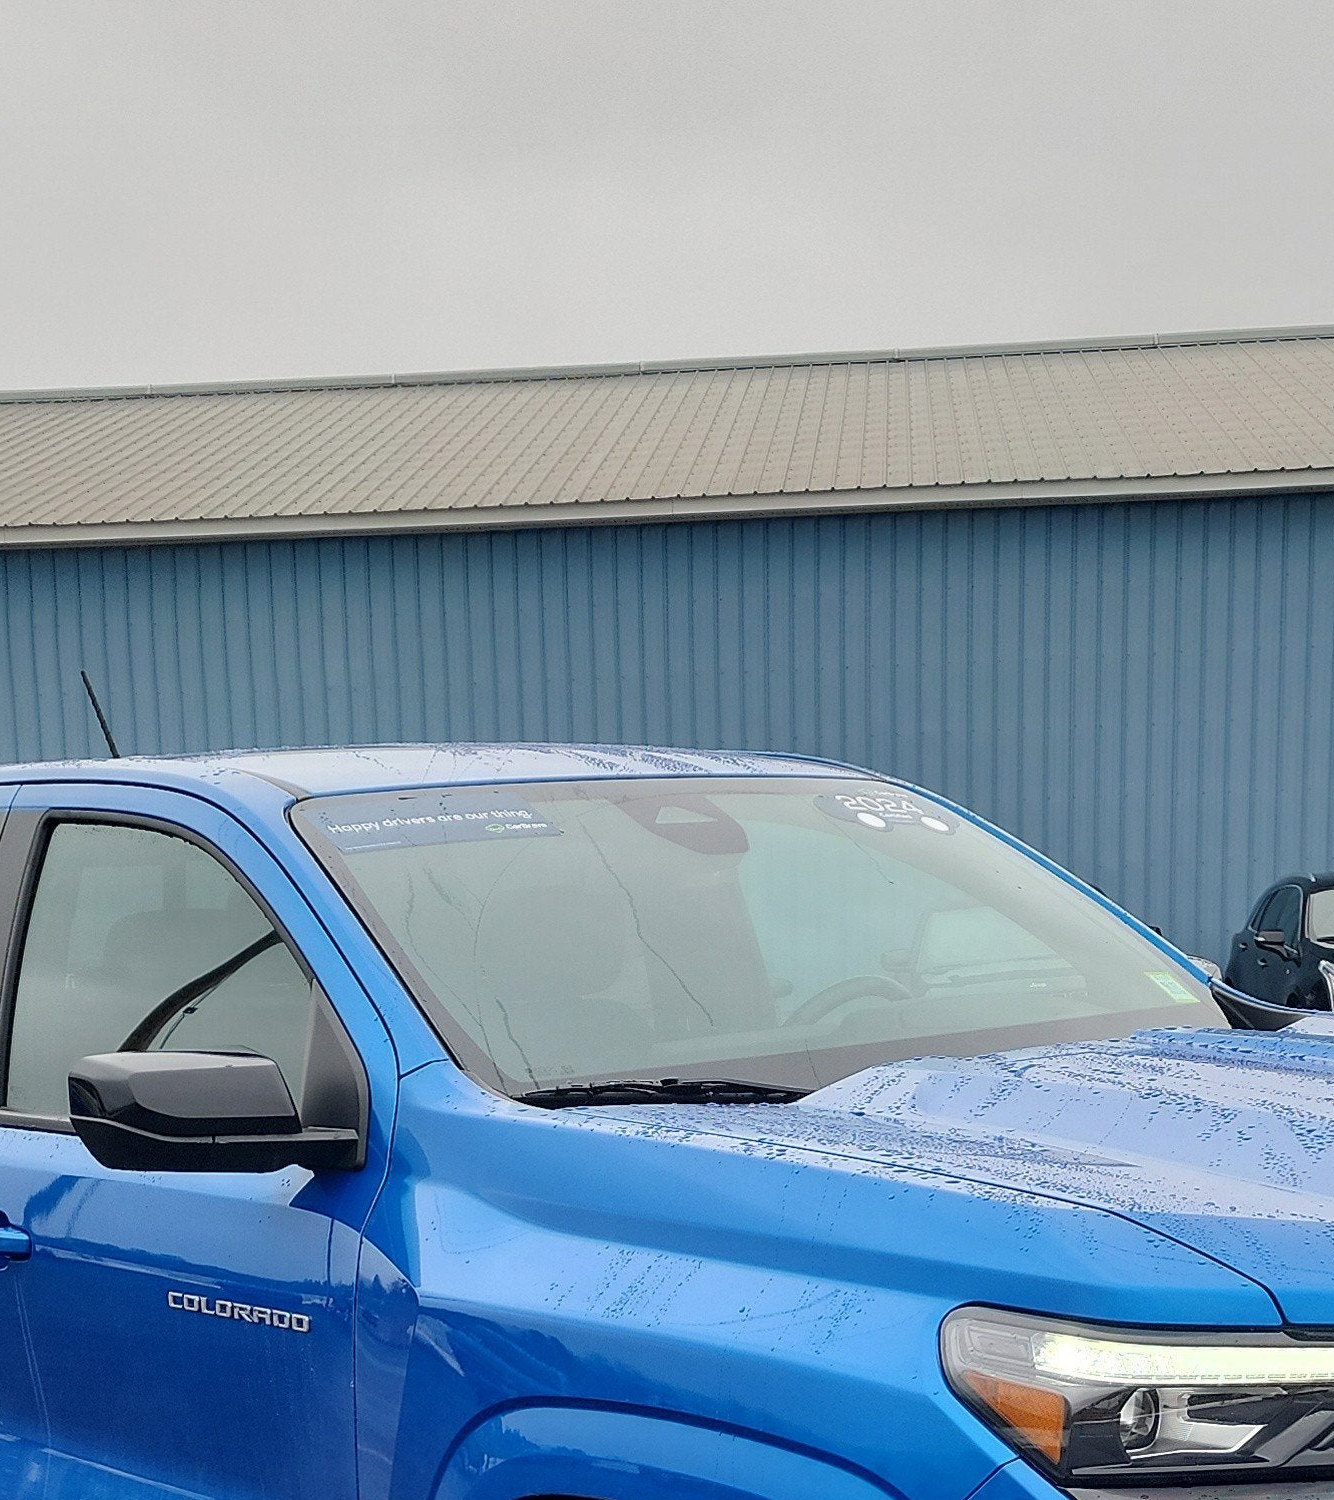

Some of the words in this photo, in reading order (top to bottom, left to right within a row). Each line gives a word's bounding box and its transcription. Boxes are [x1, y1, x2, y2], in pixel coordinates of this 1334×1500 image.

[834, 795, 925, 815] 2024
[327, 821, 380, 834] Happy
[382, 816, 436, 827] drivers
[437, 814, 464, 823] are
[465, 812, 488, 820] our
[167, 1291, 311, 1333] COLORADO
